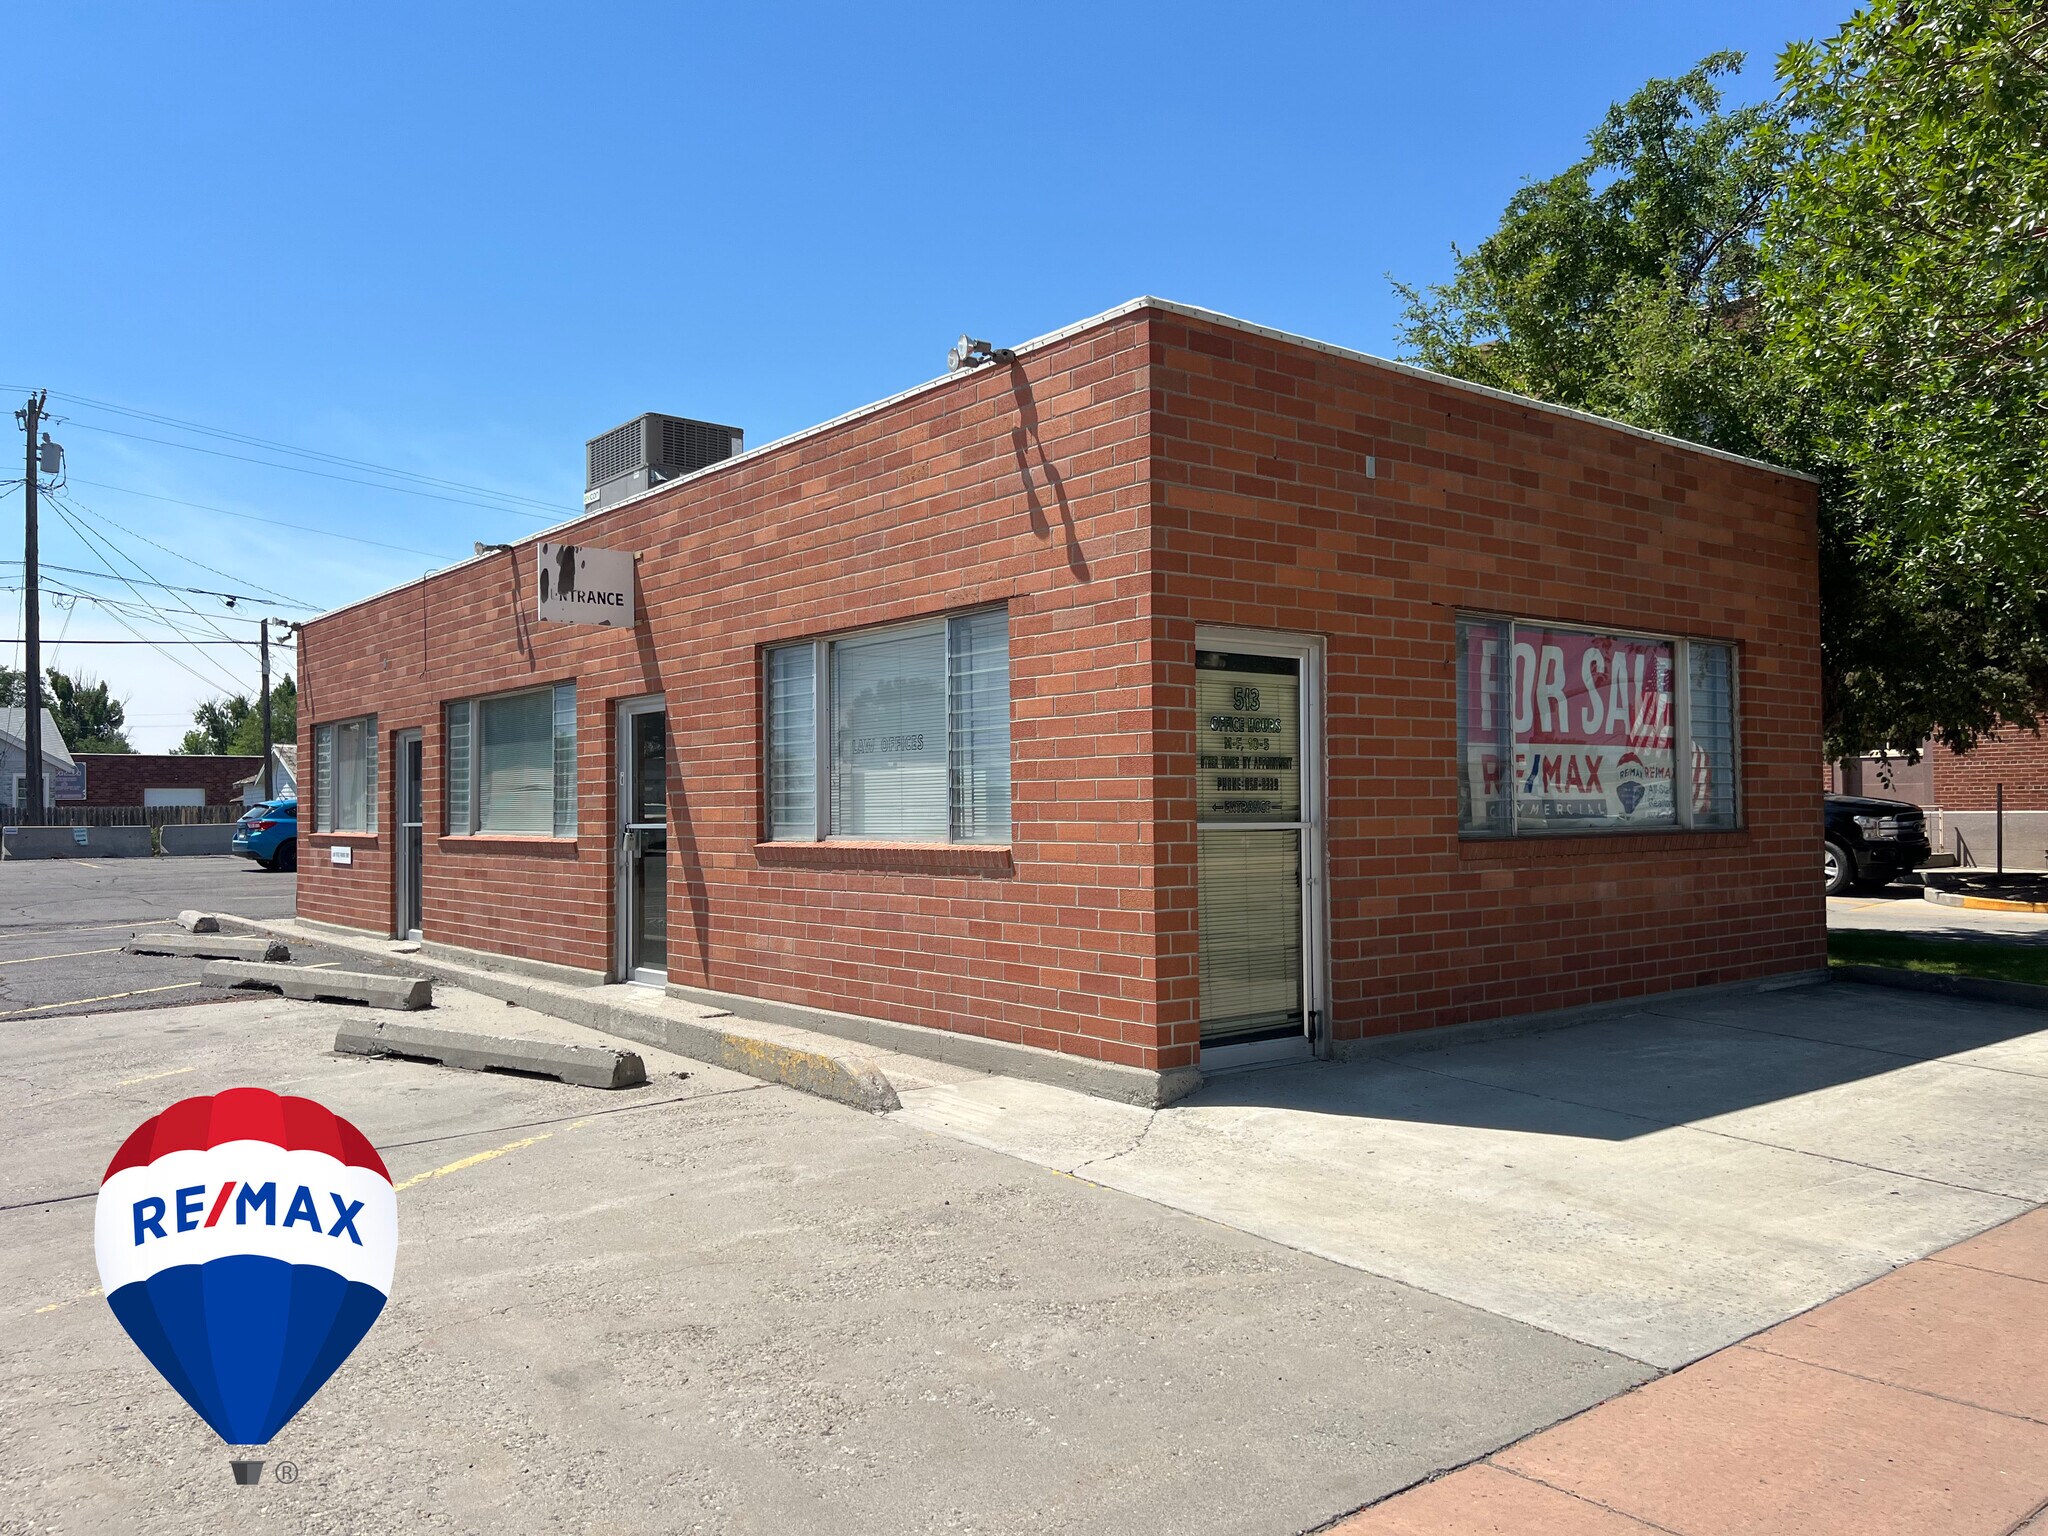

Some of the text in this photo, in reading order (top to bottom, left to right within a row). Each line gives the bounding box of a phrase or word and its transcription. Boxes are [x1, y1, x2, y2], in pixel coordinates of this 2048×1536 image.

[1481, 640, 1674, 738] FOR SALE
[1233, 687, 1261, 711] 513
[1210, 716, 1282, 734] OFFICE HOURS
[852, 734, 924, 754] LAW OFFICES
[1224, 800, 1271, 814] ENTRANCE
[1489, 802, 1605, 818] CMERCIAL
